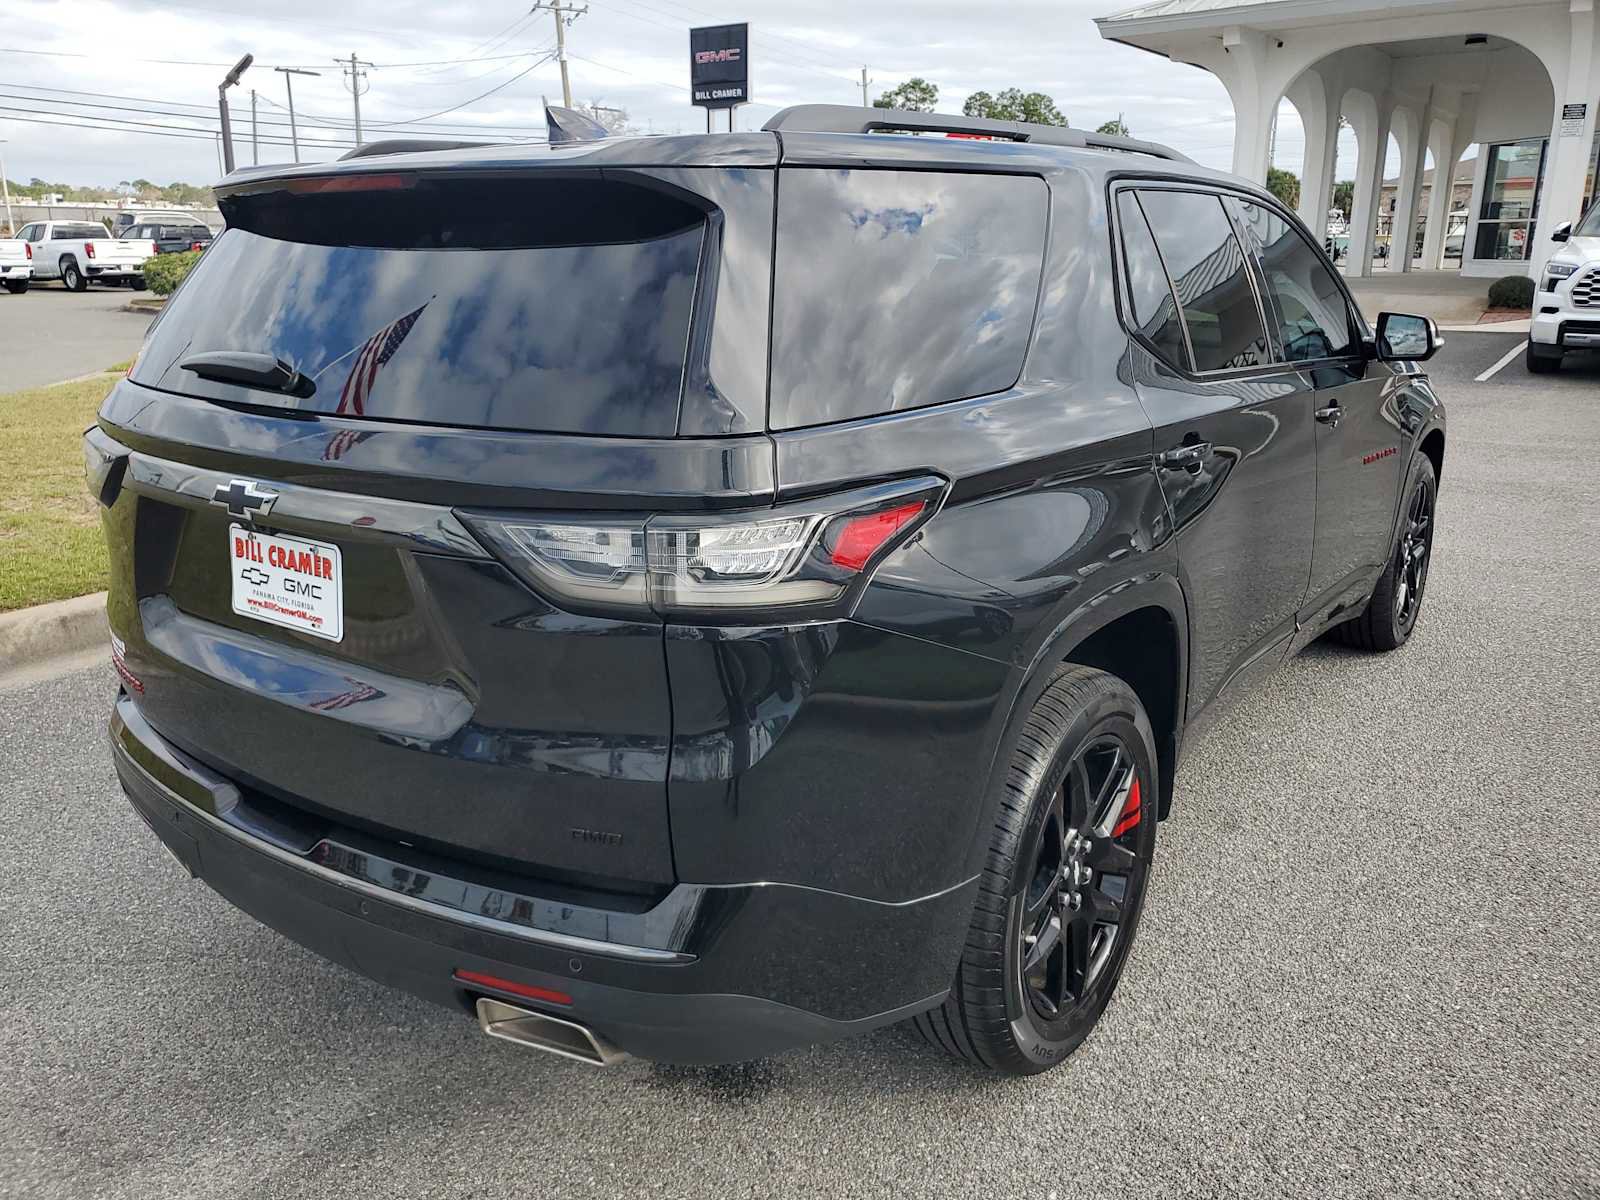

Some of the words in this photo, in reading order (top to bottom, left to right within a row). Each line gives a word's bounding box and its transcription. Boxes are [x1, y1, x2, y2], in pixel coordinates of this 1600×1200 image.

[695, 48, 741, 64] GMC
[695, 91, 711, 100] BILL
[712, 88, 742, 99] CRAMER
[235, 537, 264, 564] BILL
[268, 545, 333, 580] CRAMER
[283, 577, 322, 600] GMC
[252, 589, 275, 601] PANAMA
[291, 600, 315, 611] FLORIDA
